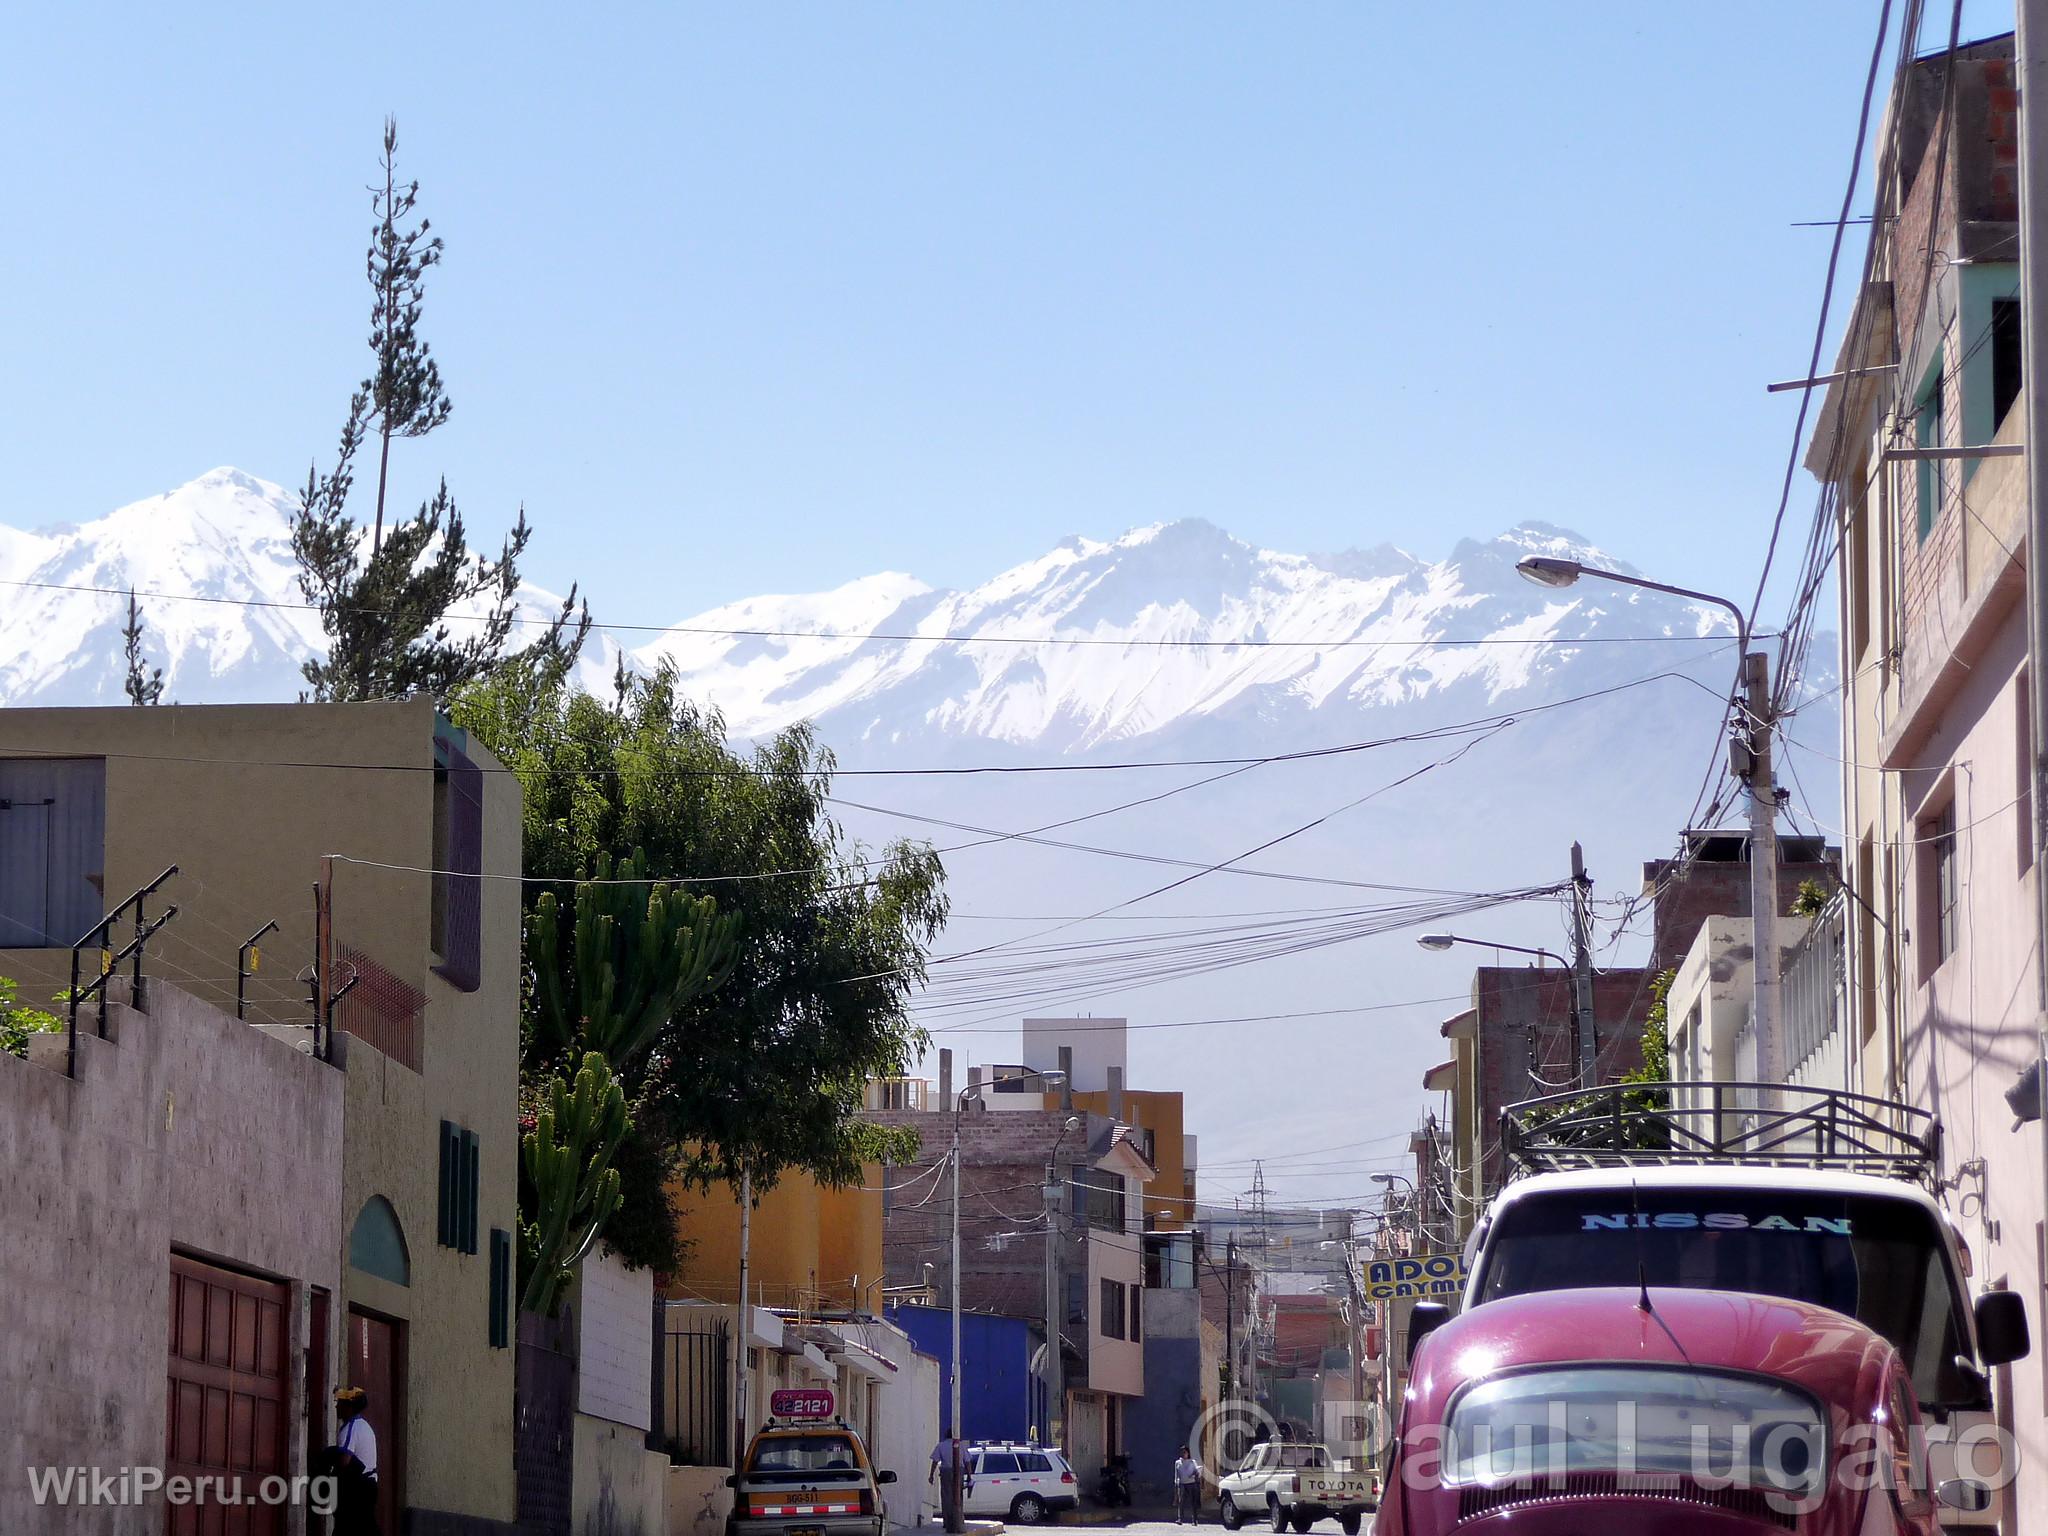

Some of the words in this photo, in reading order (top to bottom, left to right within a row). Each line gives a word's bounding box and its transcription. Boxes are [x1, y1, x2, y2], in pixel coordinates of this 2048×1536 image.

[1581, 1213, 1852, 1234] NISSAN
[774, 1399, 828, 1413] 422121
[1309, 1480, 1364, 1491] TOYOTA
